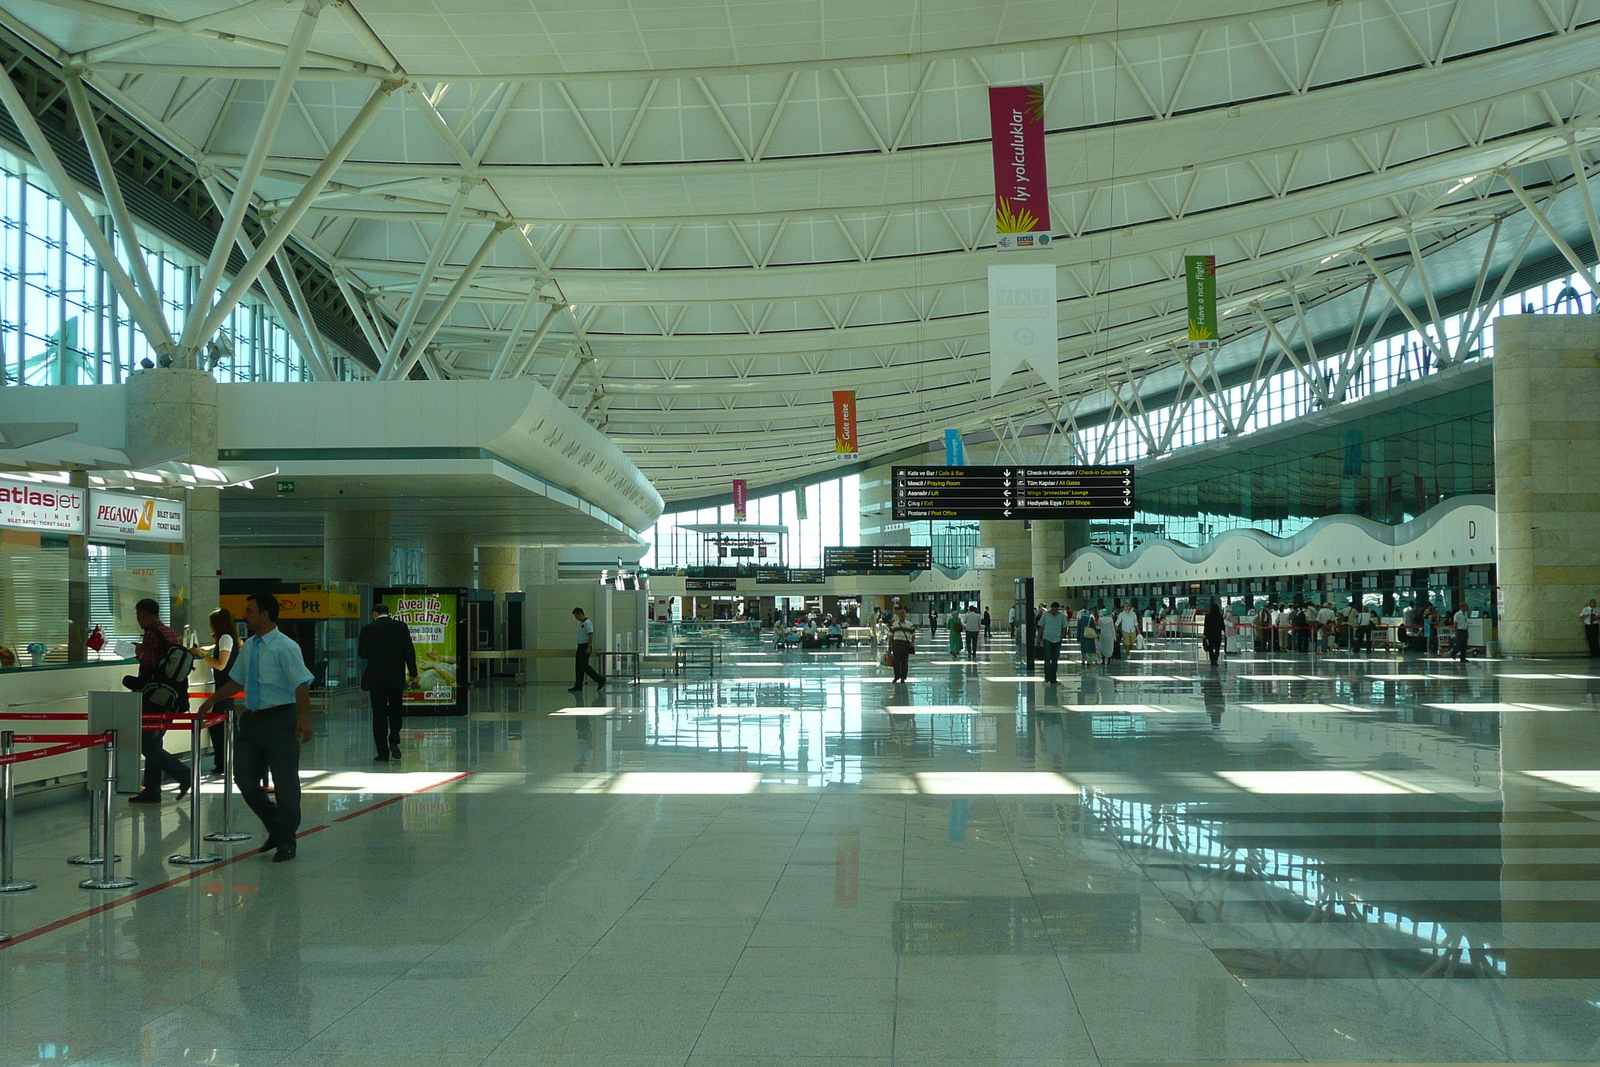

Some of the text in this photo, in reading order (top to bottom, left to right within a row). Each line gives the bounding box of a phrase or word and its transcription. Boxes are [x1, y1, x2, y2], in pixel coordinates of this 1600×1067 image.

[1009, 109, 1031, 202] İyi yolculuklar
[1195, 261, 1204, 280] flight
[0, 486, 80, 511] atlasjet
[97, 505, 139, 524] PEGASUS
[157, 510, 168, 519] BİLET
[1469, 521, 1476, 539] D
[302, 600, 320, 613] Ptt
[399, 598, 440, 611] Avea ile
[415, 611, 450, 625] rahat!
